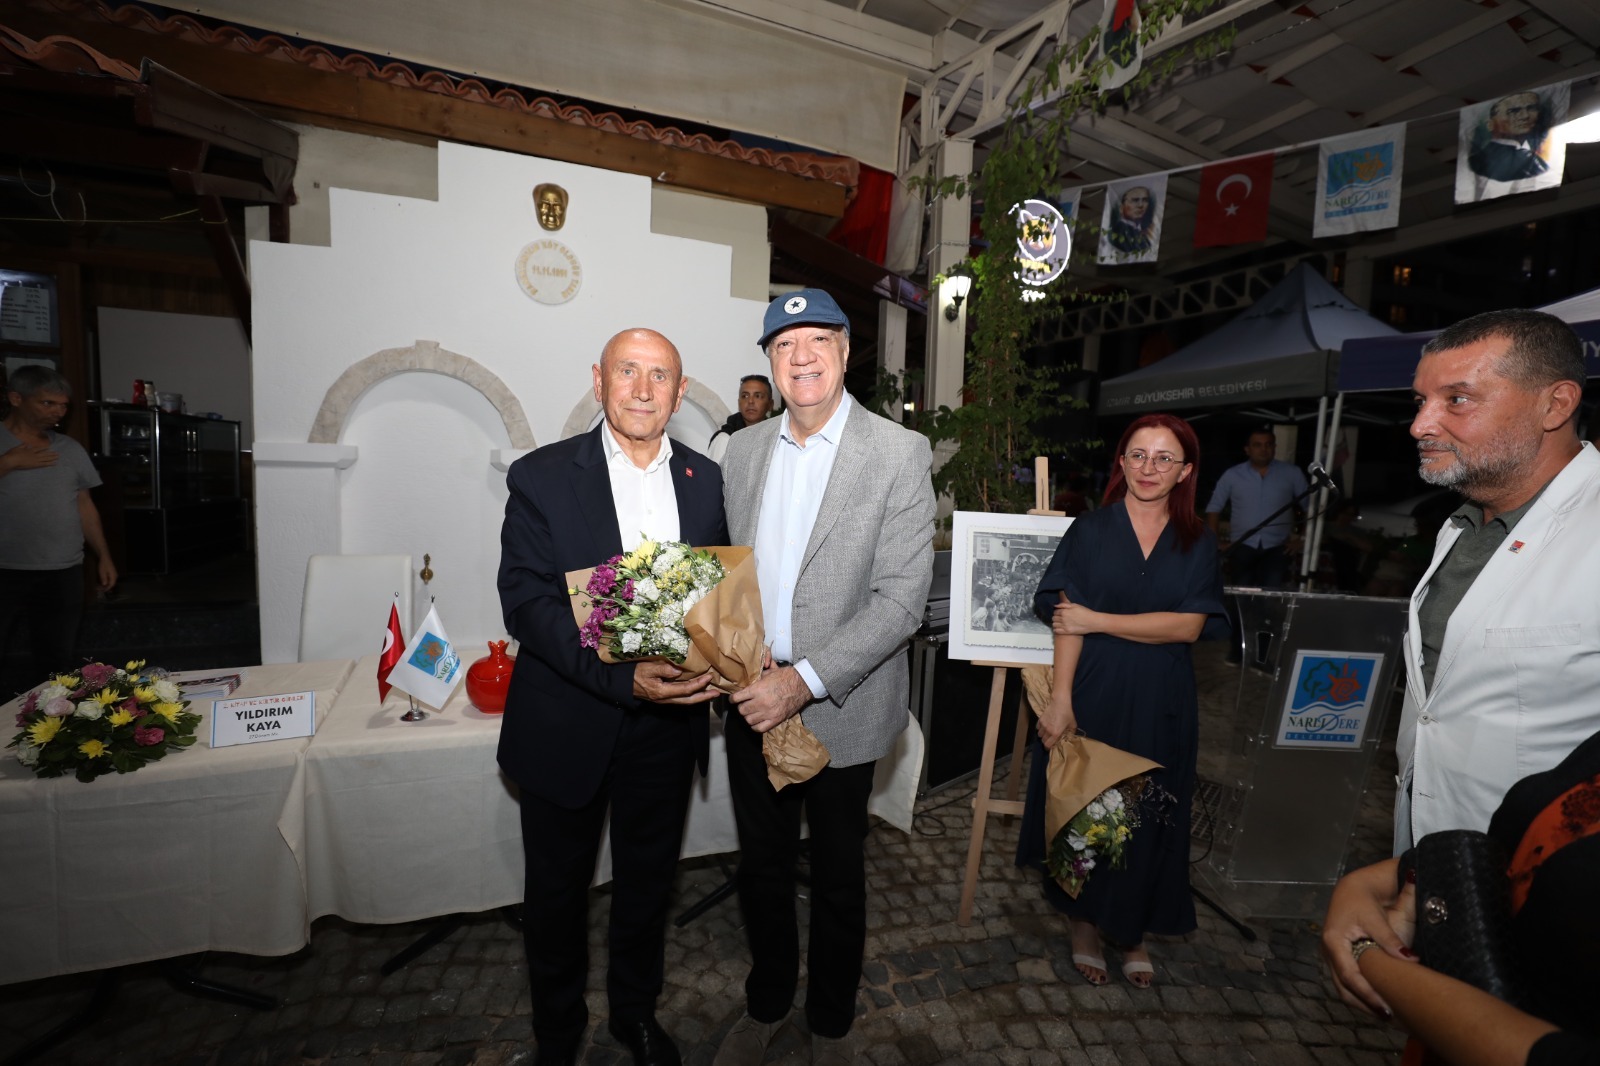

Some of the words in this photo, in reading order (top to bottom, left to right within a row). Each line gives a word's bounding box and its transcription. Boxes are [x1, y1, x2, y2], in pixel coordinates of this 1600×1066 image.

[1134, 386, 1195, 405] BÜYÜKŞEHİR
[1198, 378, 1268, 398] BELEDİYESİ
[235, 706, 293, 720] YILDIRIM
[246, 720, 281, 732] KAYA
